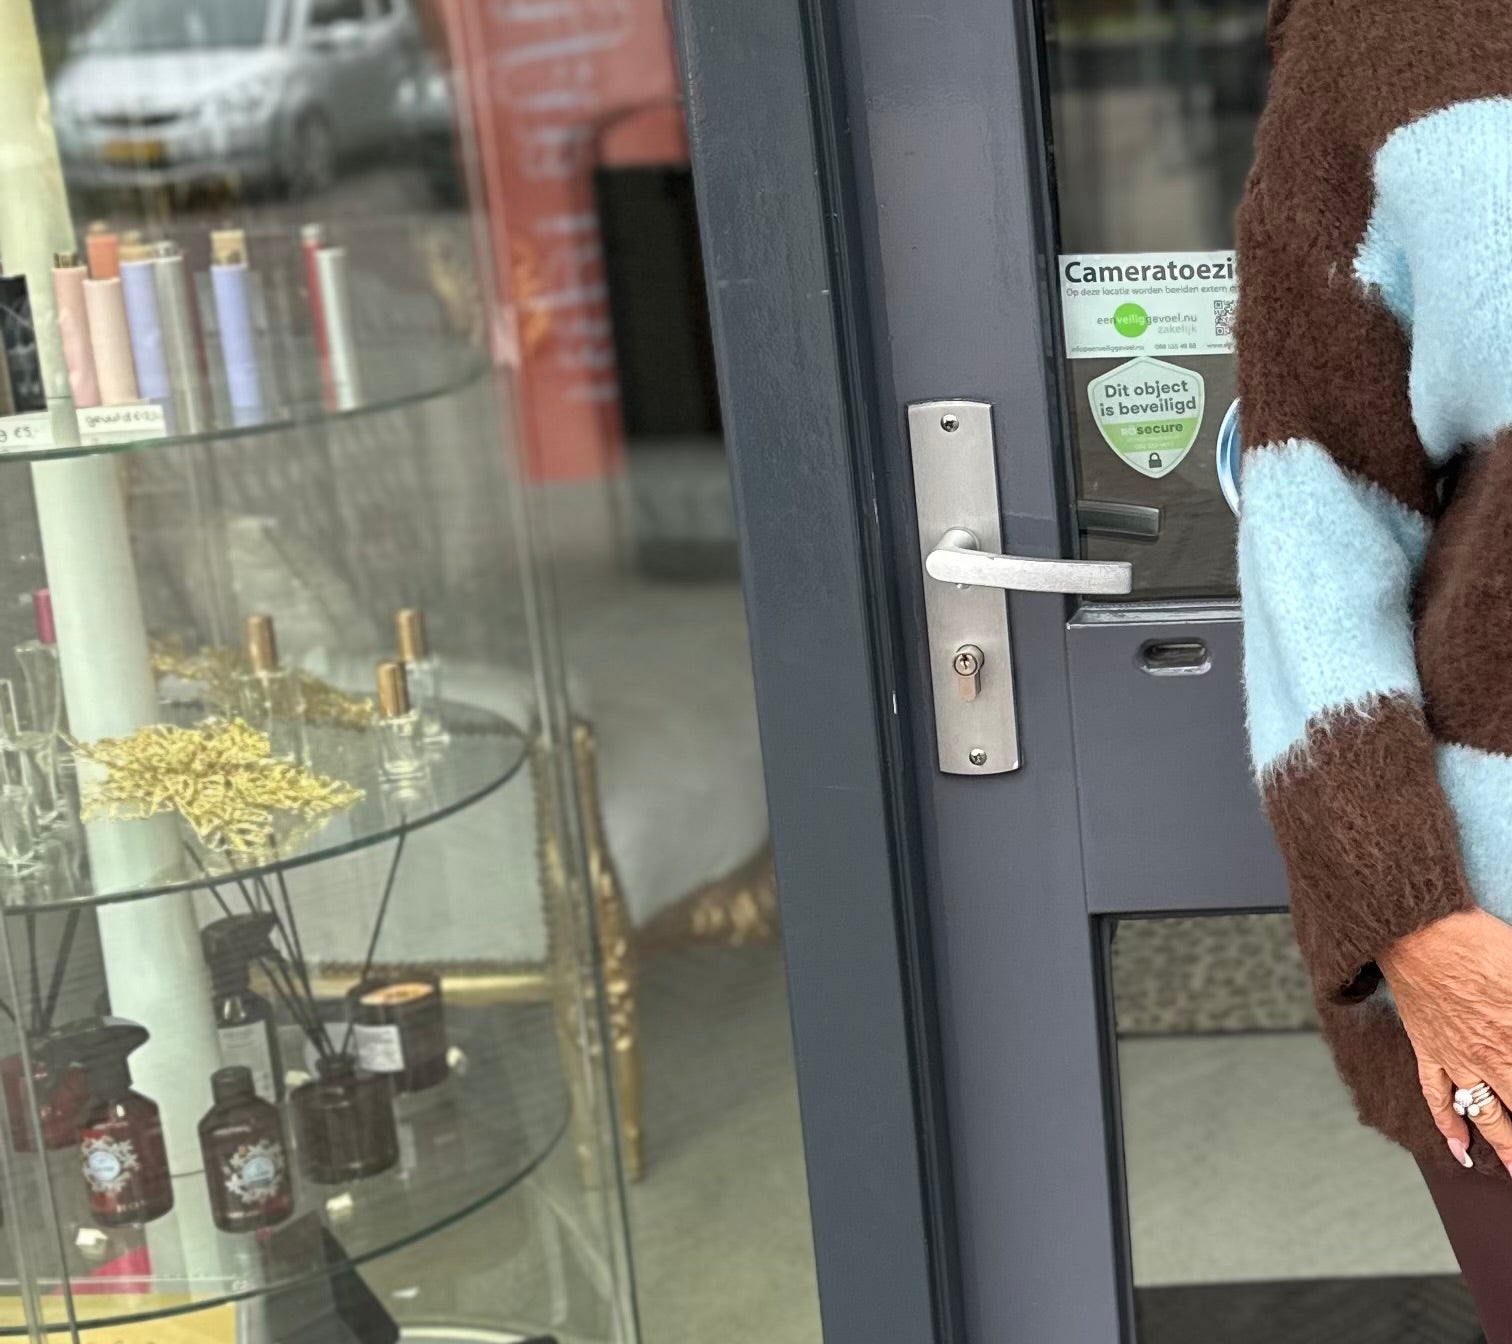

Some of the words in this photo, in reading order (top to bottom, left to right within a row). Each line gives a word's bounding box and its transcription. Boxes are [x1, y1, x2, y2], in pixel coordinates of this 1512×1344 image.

[1065, 257, 1233, 283] Cameratoezi
[1066, 288, 1079, 297] Op
[1081, 288, 1100, 296] deze
[1102, 286, 1129, 295] locatie
[1132, 286, 1163, 295] worden
[1201, 285, 1228, 294] extern
[1158, 325, 1197, 335] zakelijk
[1104, 384, 1130, 398] Dit
[1134, 380, 1189, 398] object
[1100, 403, 1114, 416] is
[1119, 396, 1197, 415] beveiligd
